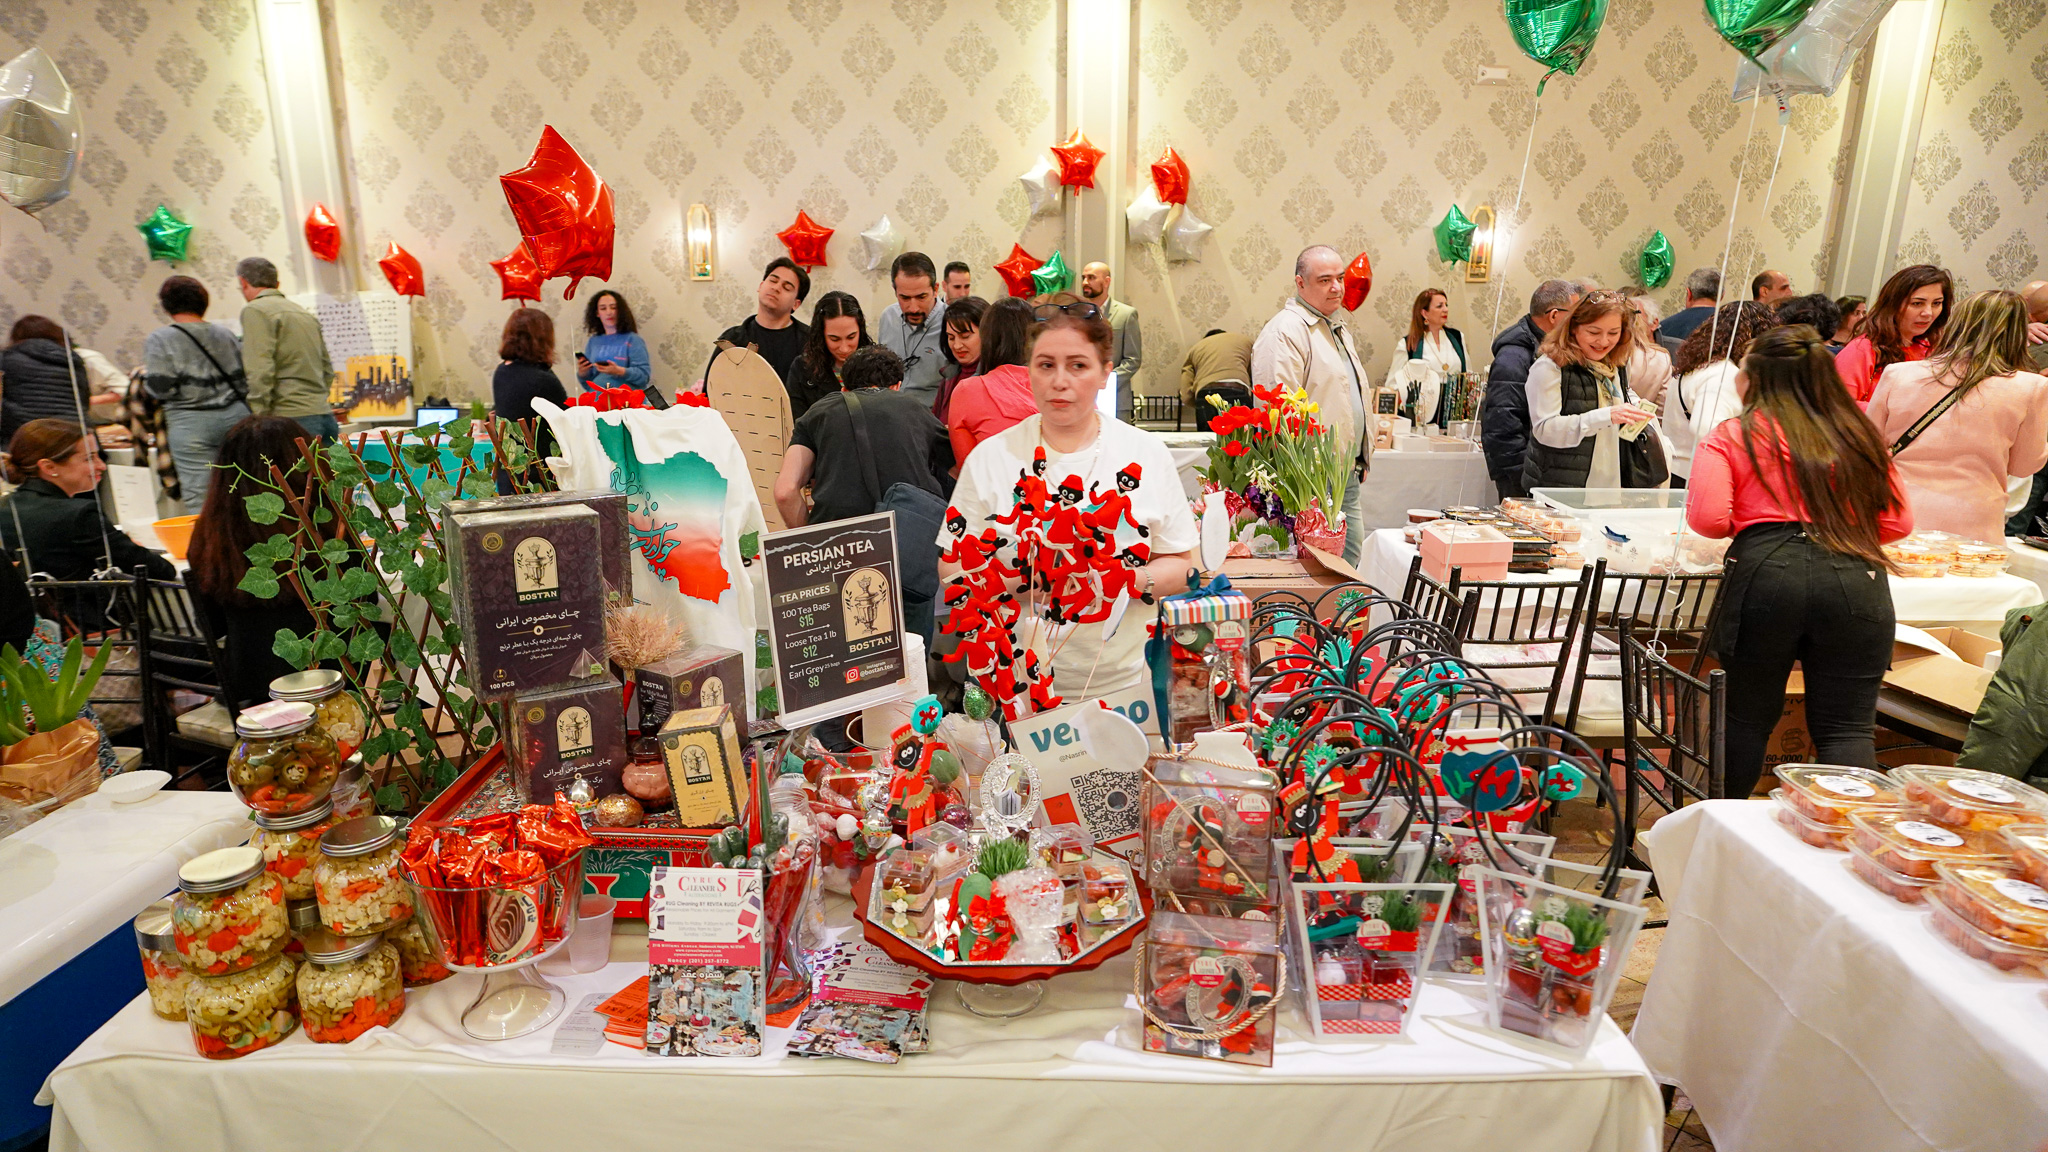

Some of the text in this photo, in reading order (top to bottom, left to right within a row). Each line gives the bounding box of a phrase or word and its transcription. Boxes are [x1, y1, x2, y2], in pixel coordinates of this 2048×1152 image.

[783, 540, 874, 568] PERSIAN TEA
[806, 558, 852, 576] چای ایرانی
[520, 591, 558, 602] BOSTAN
[780, 585, 830, 603] TEA PRICES
[782, 602, 830, 618] 100 Tea Bags
[496, 608, 580, 629] چای مخصوص ایرانی
[798, 614, 814, 628] $15
[785, 630, 837, 650] Loose Tea 1 lb
[848, 635, 892, 653] BOSTAN
[802, 644, 818, 659] $12
[788, 670, 804, 680] Earl
[806, 665, 824, 676] Grey
[860, 664, 894, 678] @bostan.tea
[642, 681, 664, 690] BOSTAN
[808, 675, 820, 688] $8
[560, 748, 592, 759] BOSTAN
[543, 758, 612, 778] چای مخصوص ایرانی
[688, 776, 711, 784] BOSTAN
[681, 970, 696, 978] عقد
